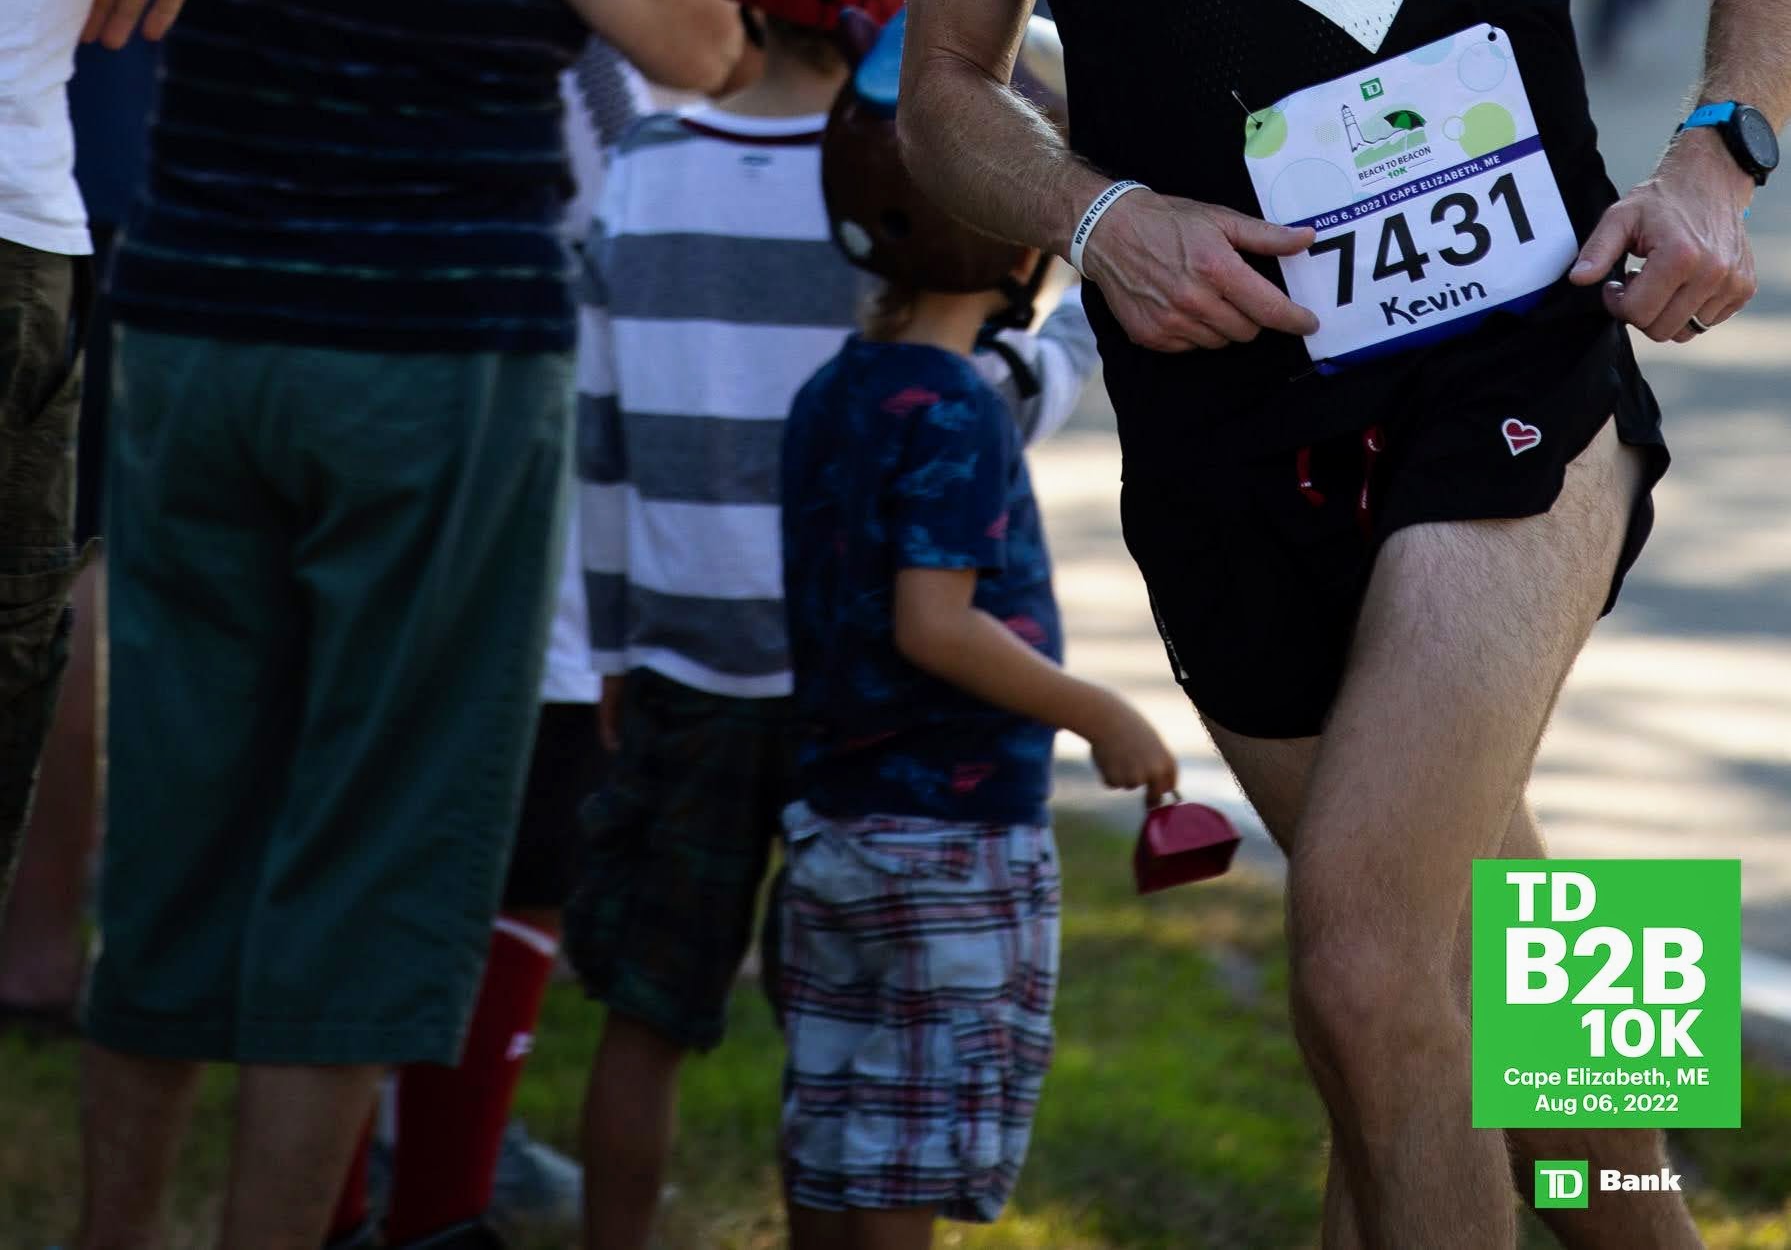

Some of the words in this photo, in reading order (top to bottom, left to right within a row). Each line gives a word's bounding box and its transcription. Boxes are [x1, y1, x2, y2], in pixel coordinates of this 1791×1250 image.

[1362, 82, 1381, 96] TD
[1359, 164, 1385, 180] BEACH
[1386, 159, 1397, 168] TO
[1398, 146, 1431, 164] BEACON
[1388, 166, 1408, 179] 10K
[1315, 215, 1338, 229] AUG
[1341, 210, 1353, 220] 6,
[1355, 199, 1381, 216] 2022
[1390, 185, 1418, 202] CAPE
[1421, 163, 1483, 191] ELIZABETH,
[1484, 155, 1501, 168] ME
[1308, 173, 1535, 307] 7431
[1380, 280, 1488, 327] Kevin
